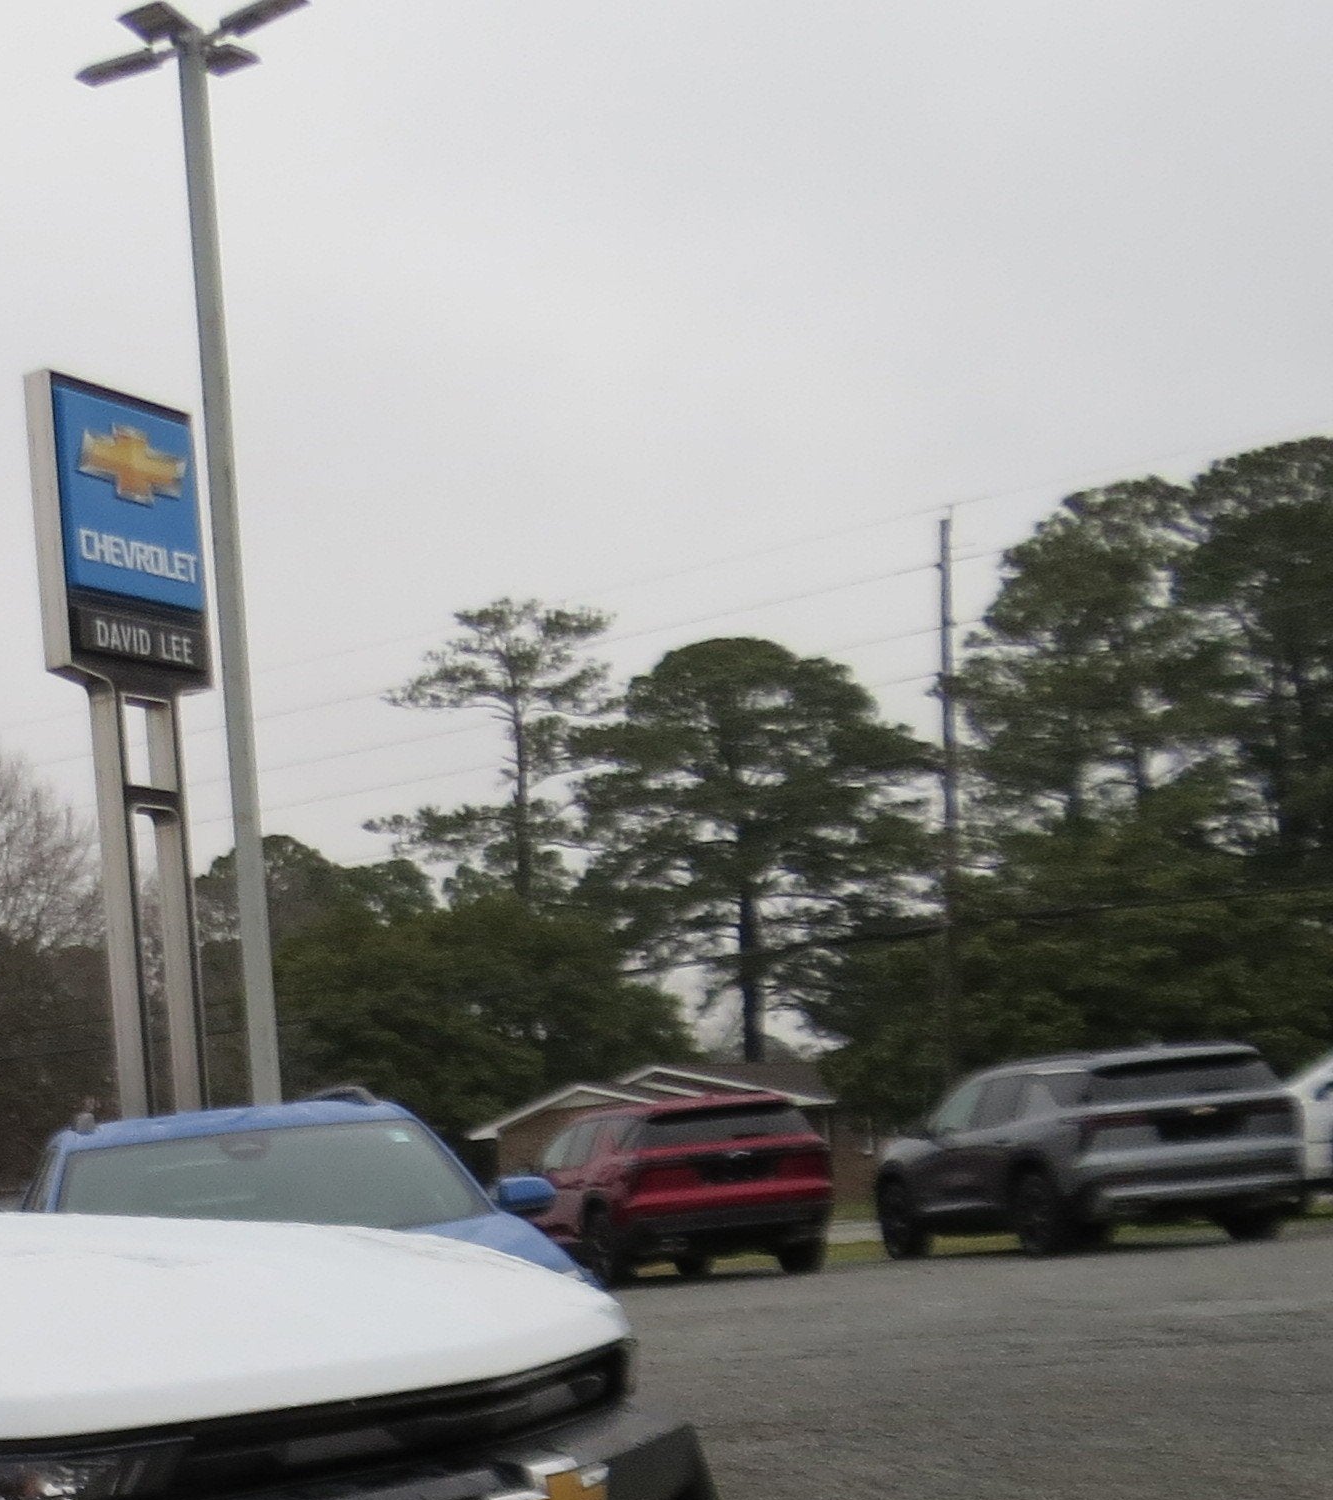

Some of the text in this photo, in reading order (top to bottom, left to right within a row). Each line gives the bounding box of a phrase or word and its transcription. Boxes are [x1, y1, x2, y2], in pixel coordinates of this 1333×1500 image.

[79, 528, 196, 583] CHEVROLET
[95, 619, 193, 664] DAVID LEE
